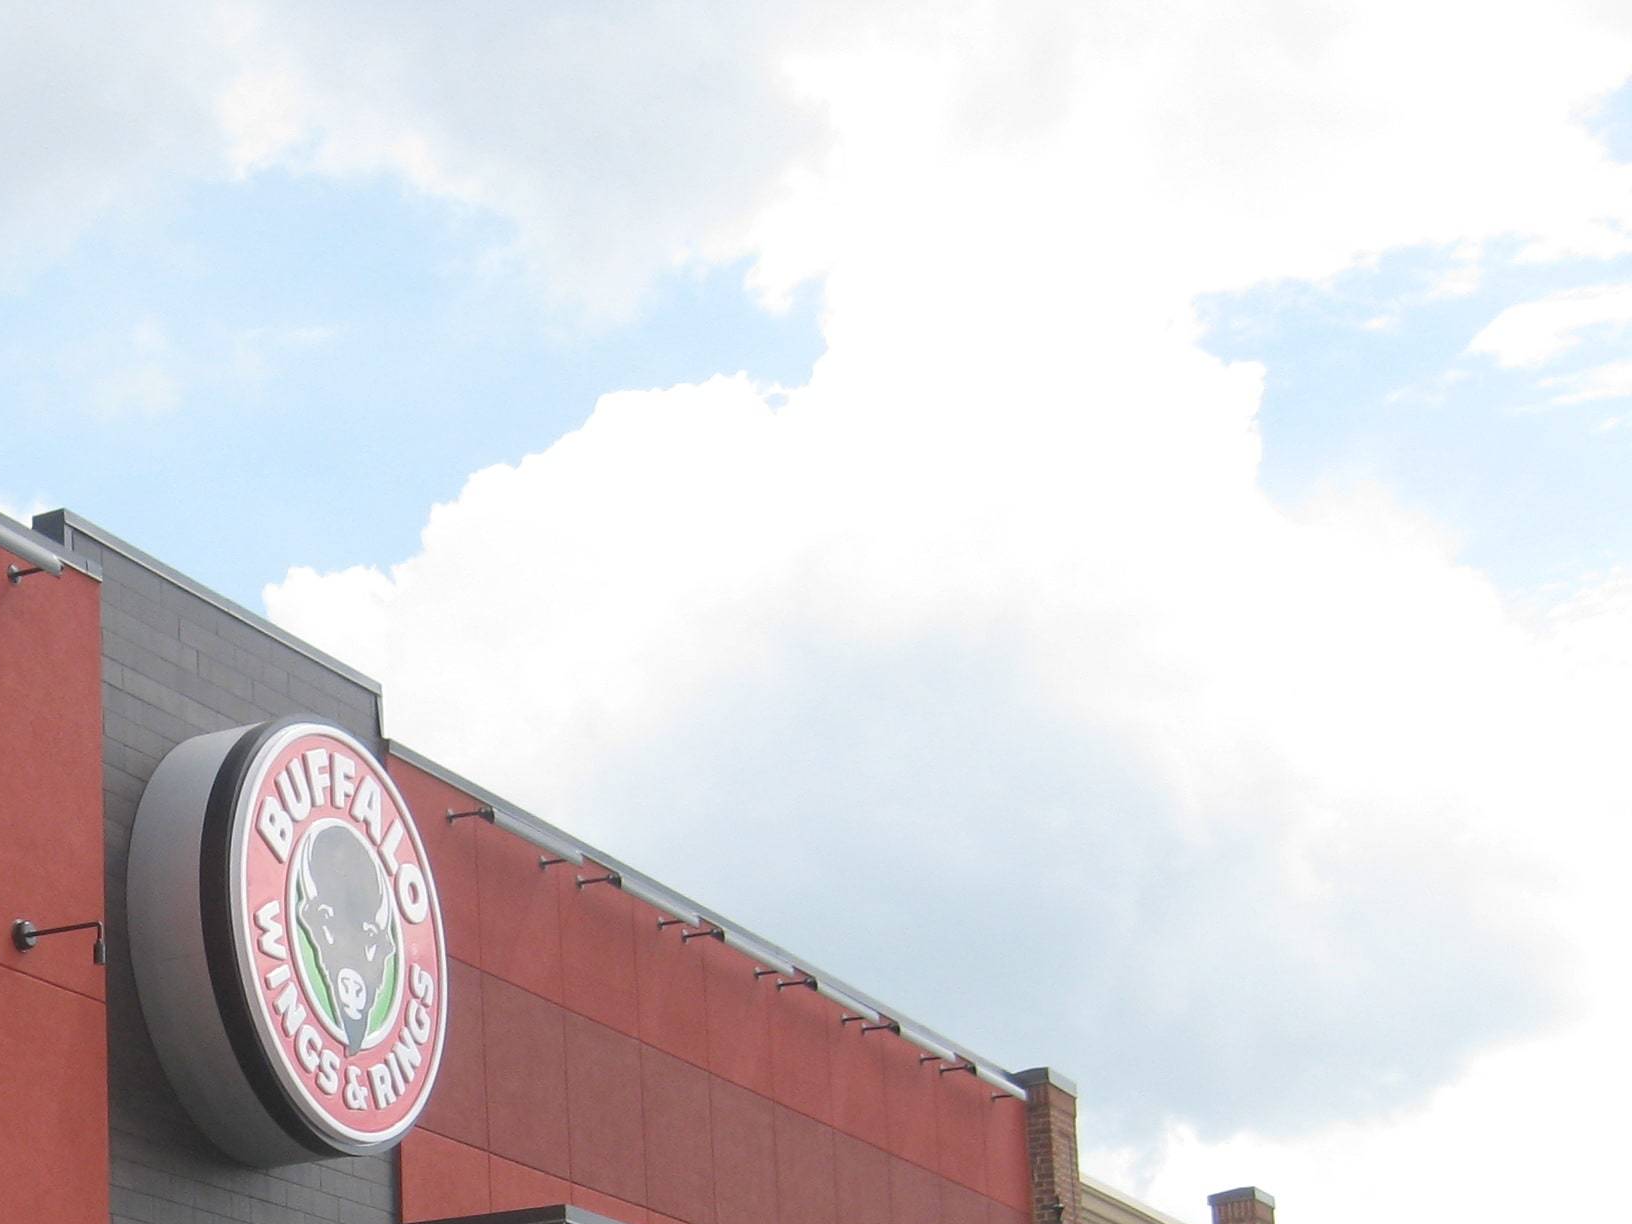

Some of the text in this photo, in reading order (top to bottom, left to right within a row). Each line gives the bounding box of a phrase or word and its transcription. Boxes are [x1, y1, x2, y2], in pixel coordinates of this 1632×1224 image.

[257, 748, 428, 924] BUFFALO
[256, 900, 434, 1111] WINGS & RINGS
